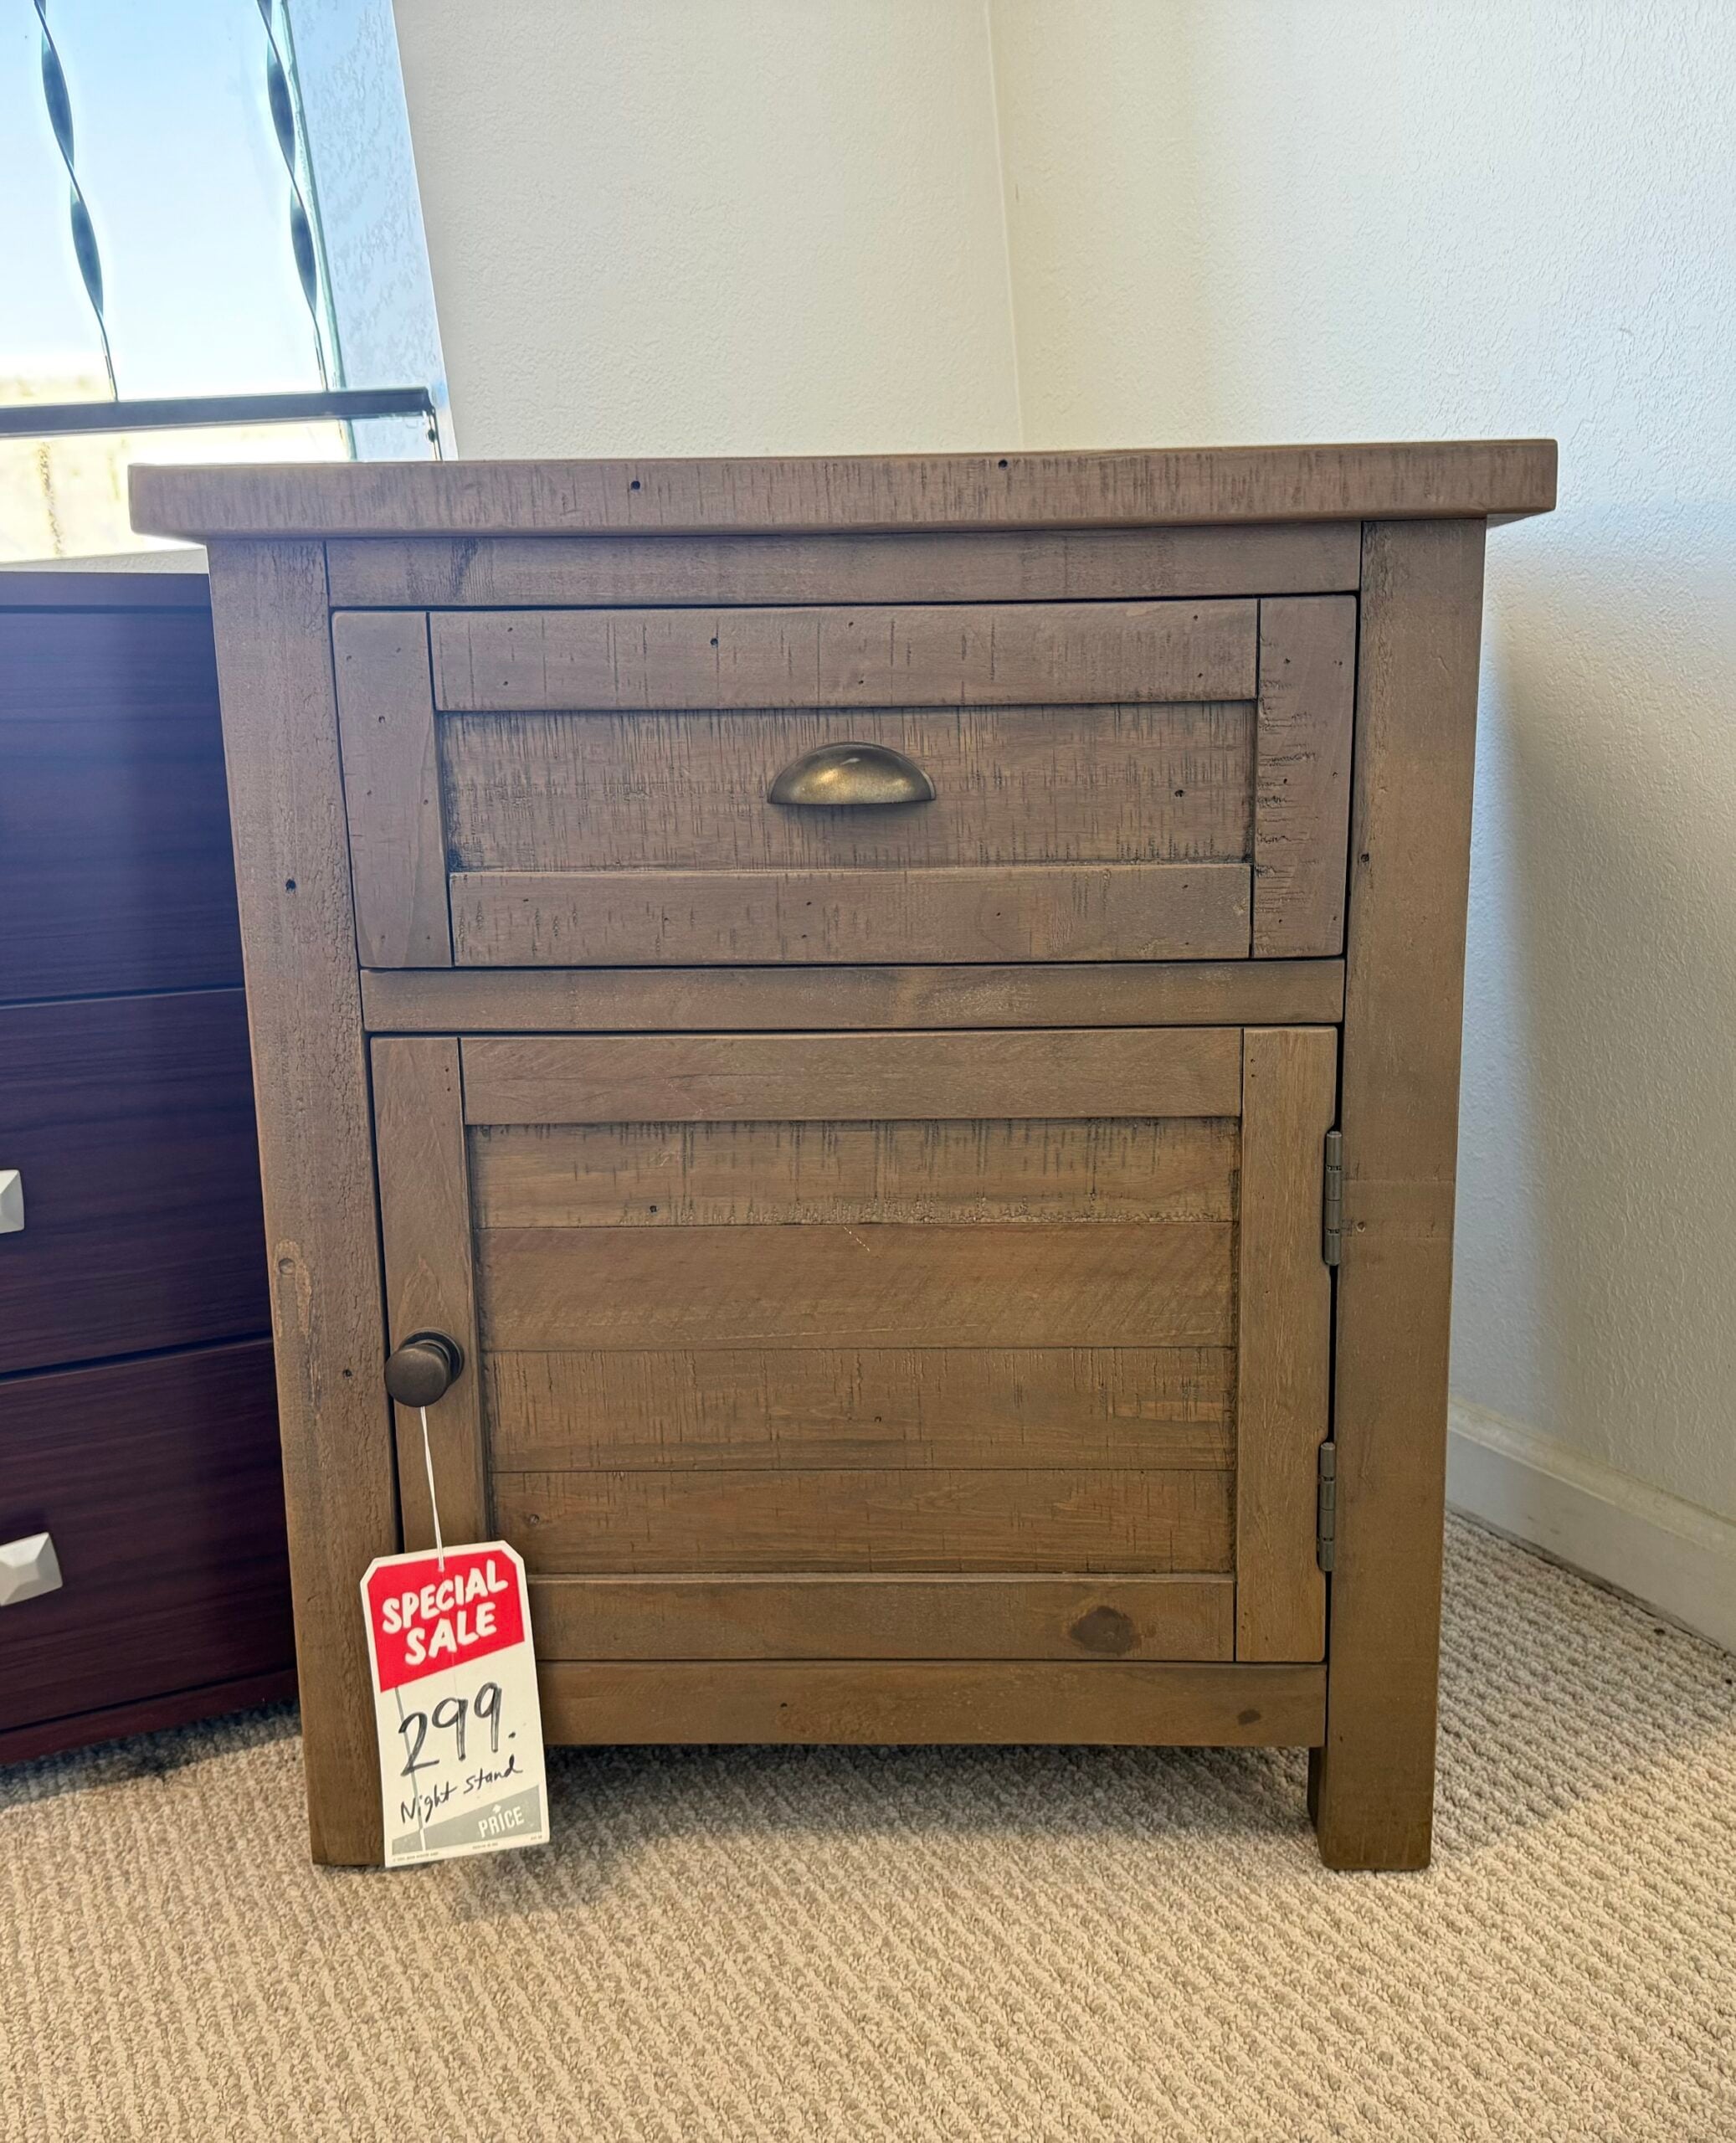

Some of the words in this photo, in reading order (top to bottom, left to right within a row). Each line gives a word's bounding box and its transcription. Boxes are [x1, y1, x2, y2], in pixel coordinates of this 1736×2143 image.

[382, 1560, 508, 1634] SPECIAL
[405, 1602, 497, 1666] SALE
[400, 1781, 458, 1824] Night
[478, 1805, 525, 1839] PRICE
